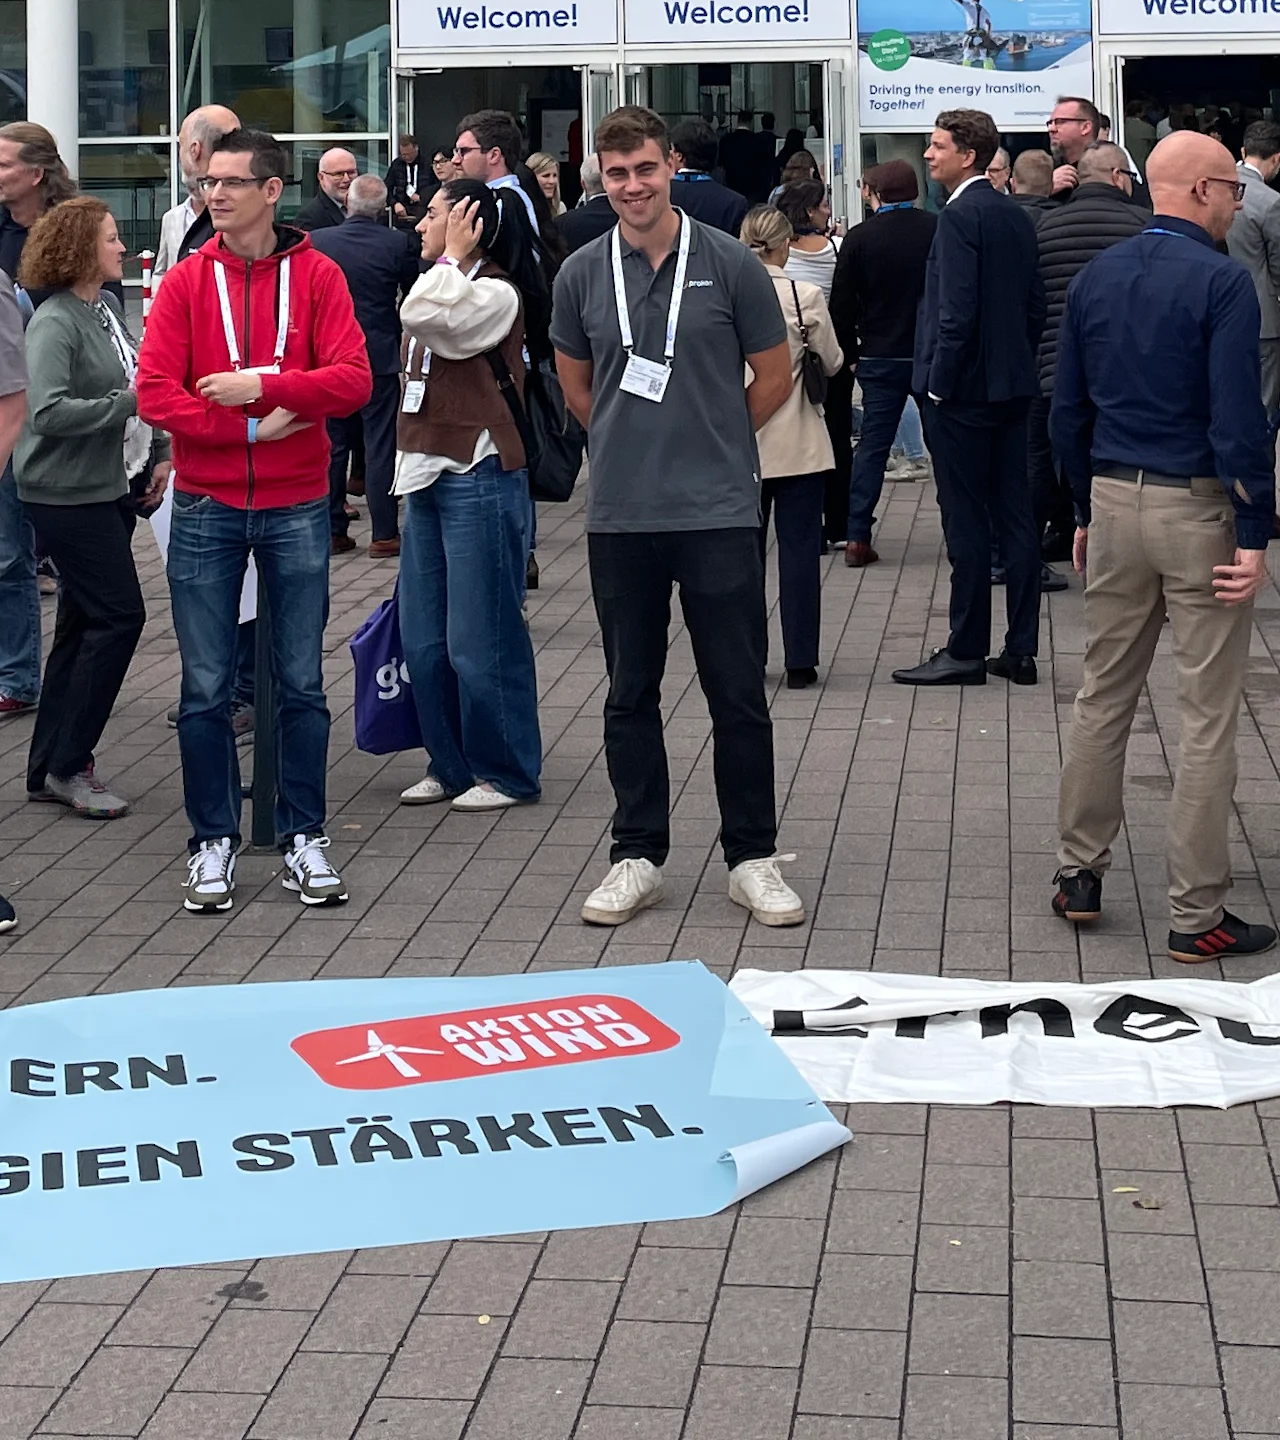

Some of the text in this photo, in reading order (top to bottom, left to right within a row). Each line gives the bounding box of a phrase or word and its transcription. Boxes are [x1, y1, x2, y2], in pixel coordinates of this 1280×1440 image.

[436, 2, 578, 30] Welcome!
[869, 82, 1045, 98] Driving the energy transition.
[869, 98, 926, 112] Together!
[439, 1002, 623, 1044] AKTION
[454, 1021, 652, 1067] WIND
[232, 1102, 704, 1174] STÄRKEN.
